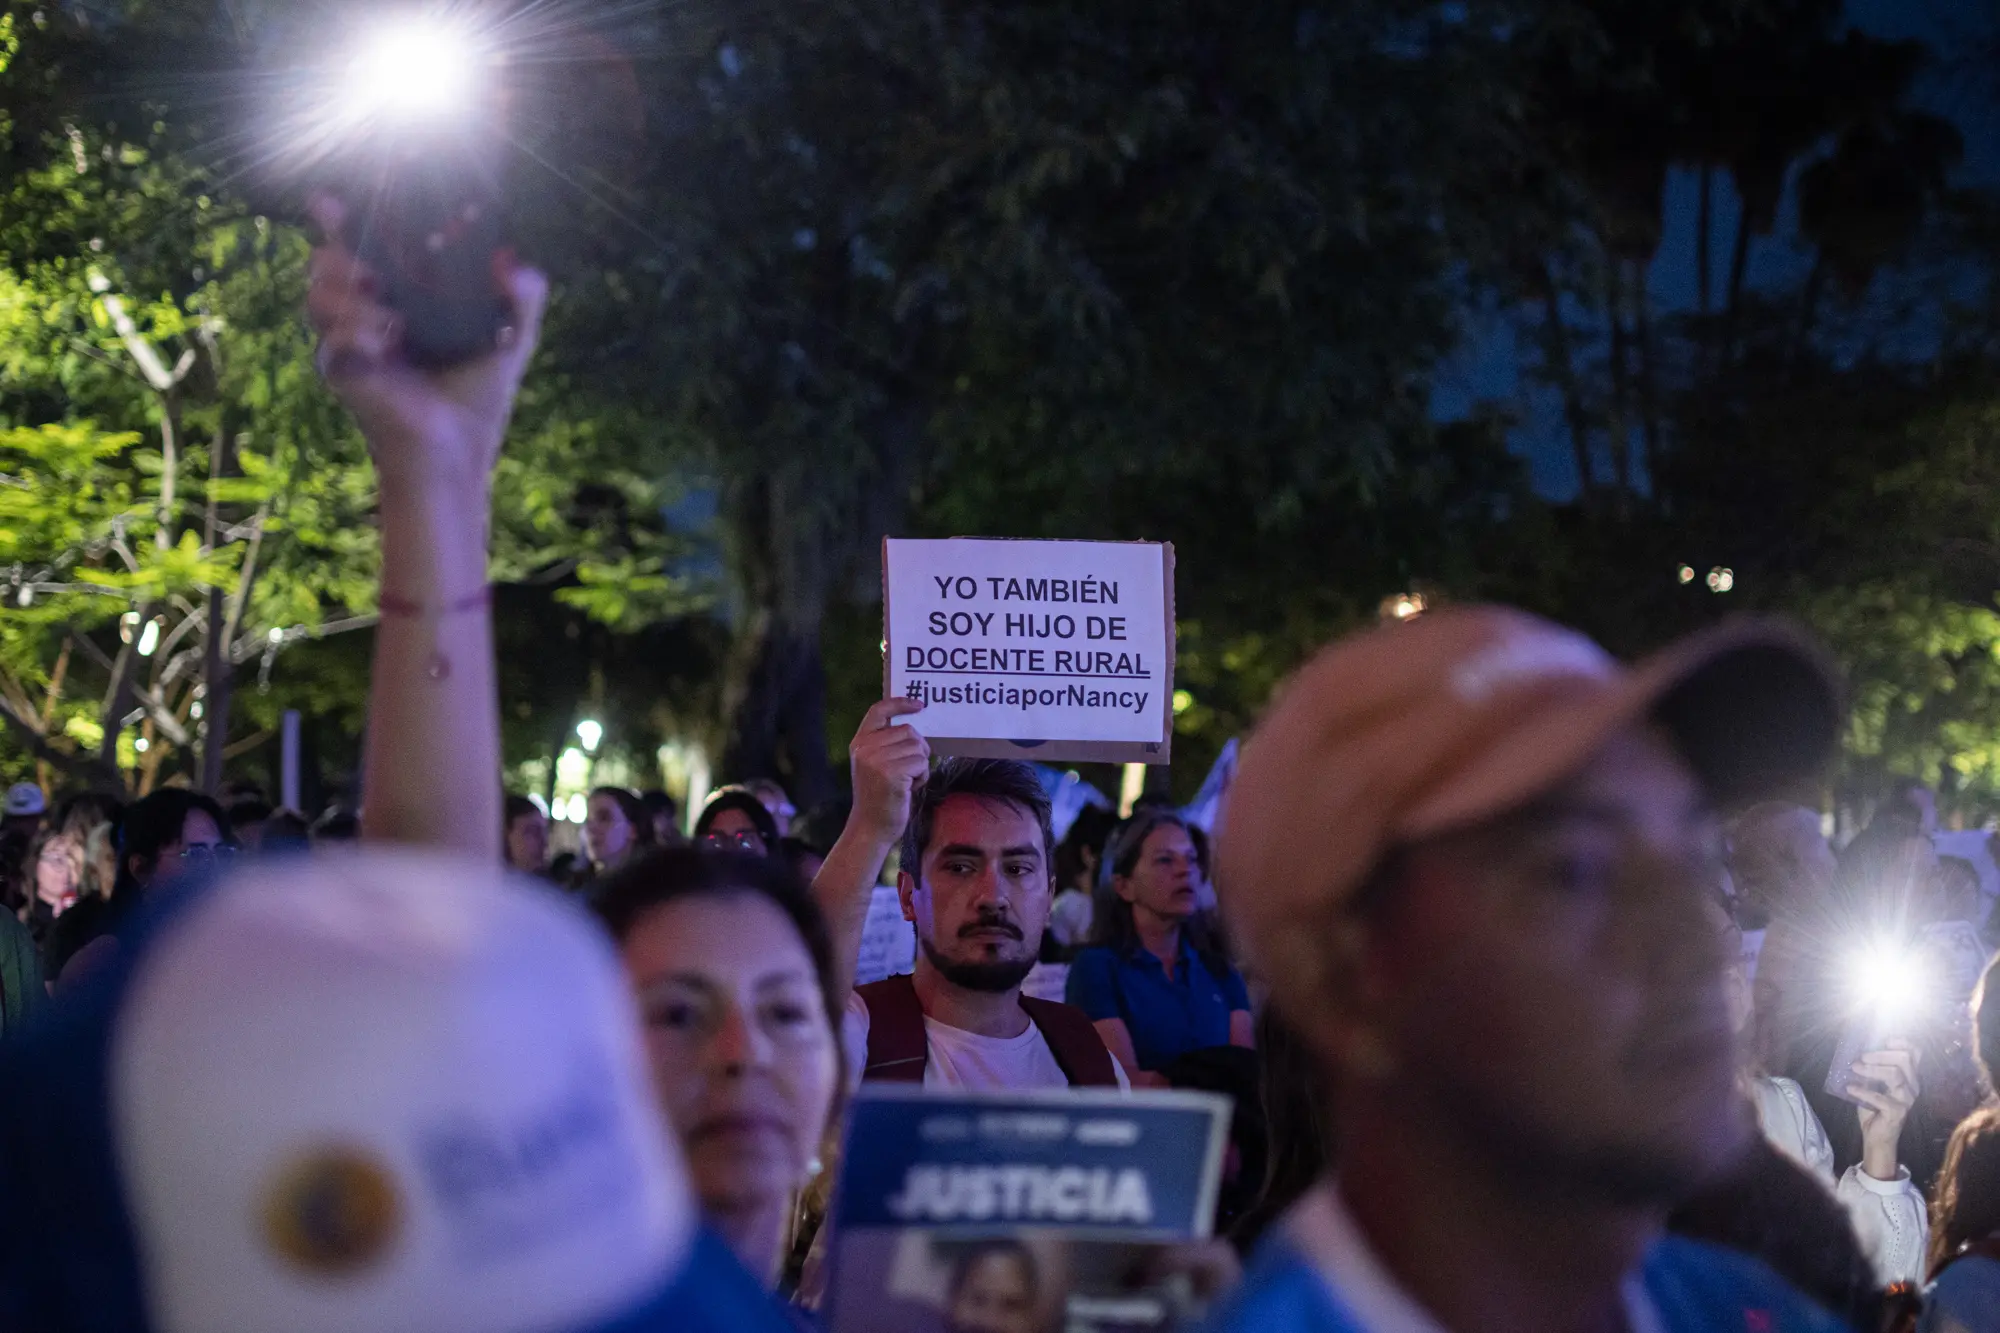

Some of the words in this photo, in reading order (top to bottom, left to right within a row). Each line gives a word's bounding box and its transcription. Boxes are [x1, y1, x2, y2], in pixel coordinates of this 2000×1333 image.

[934, 577, 977, 599] YO
[987, 575, 1118, 604] TAMBIÉN
[928, 611, 994, 636] SOY
[1006, 613, 1075, 639] HIJO
[1087, 617, 1127, 640] DE
[906, 647, 1045, 671] DOCENTE
[1055, 651, 1150, 674] RURAL
[906, 680, 1148, 713] #justiciaporNancy
[888, 1165, 1154, 1221] JUSTICIA
